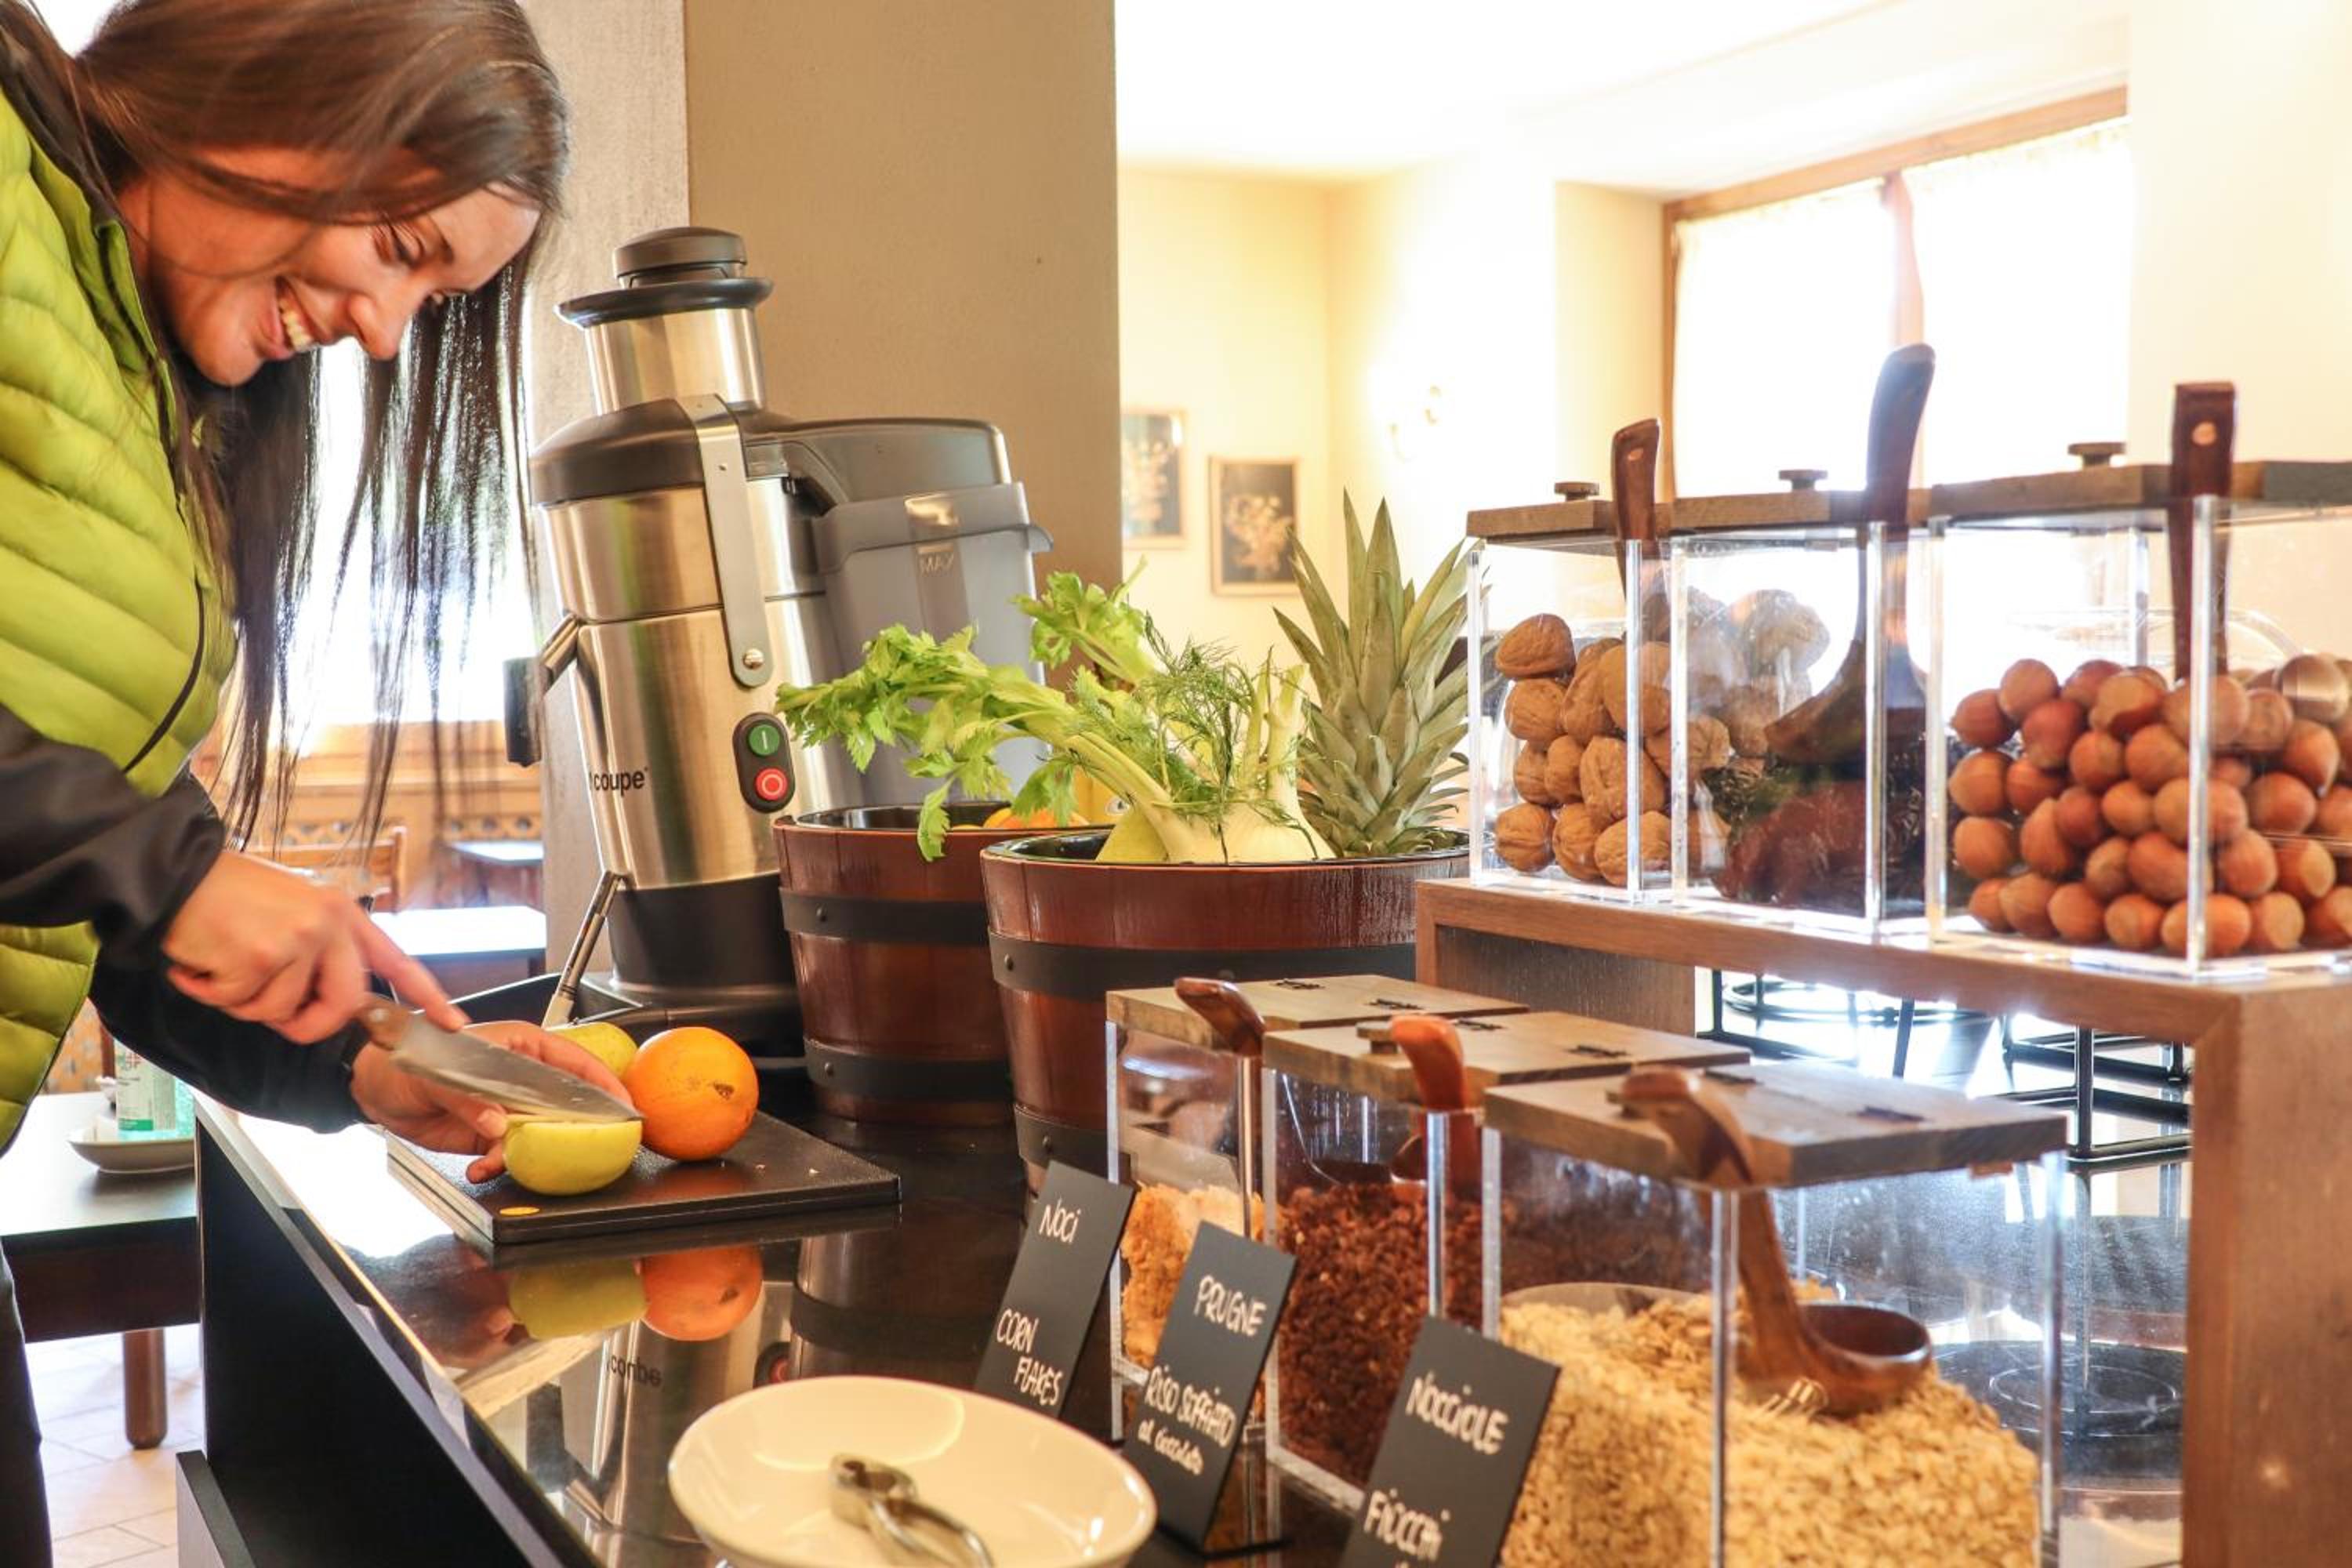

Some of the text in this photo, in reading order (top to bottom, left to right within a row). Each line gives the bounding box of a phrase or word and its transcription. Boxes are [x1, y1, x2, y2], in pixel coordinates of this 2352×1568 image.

[594, 771, 644, 797] coupe
[1194, 1275, 1267, 1336] PRUGNE
[996, 1308, 1039, 1353] CORN
[1014, 1357, 1062, 1406] FLAKES
